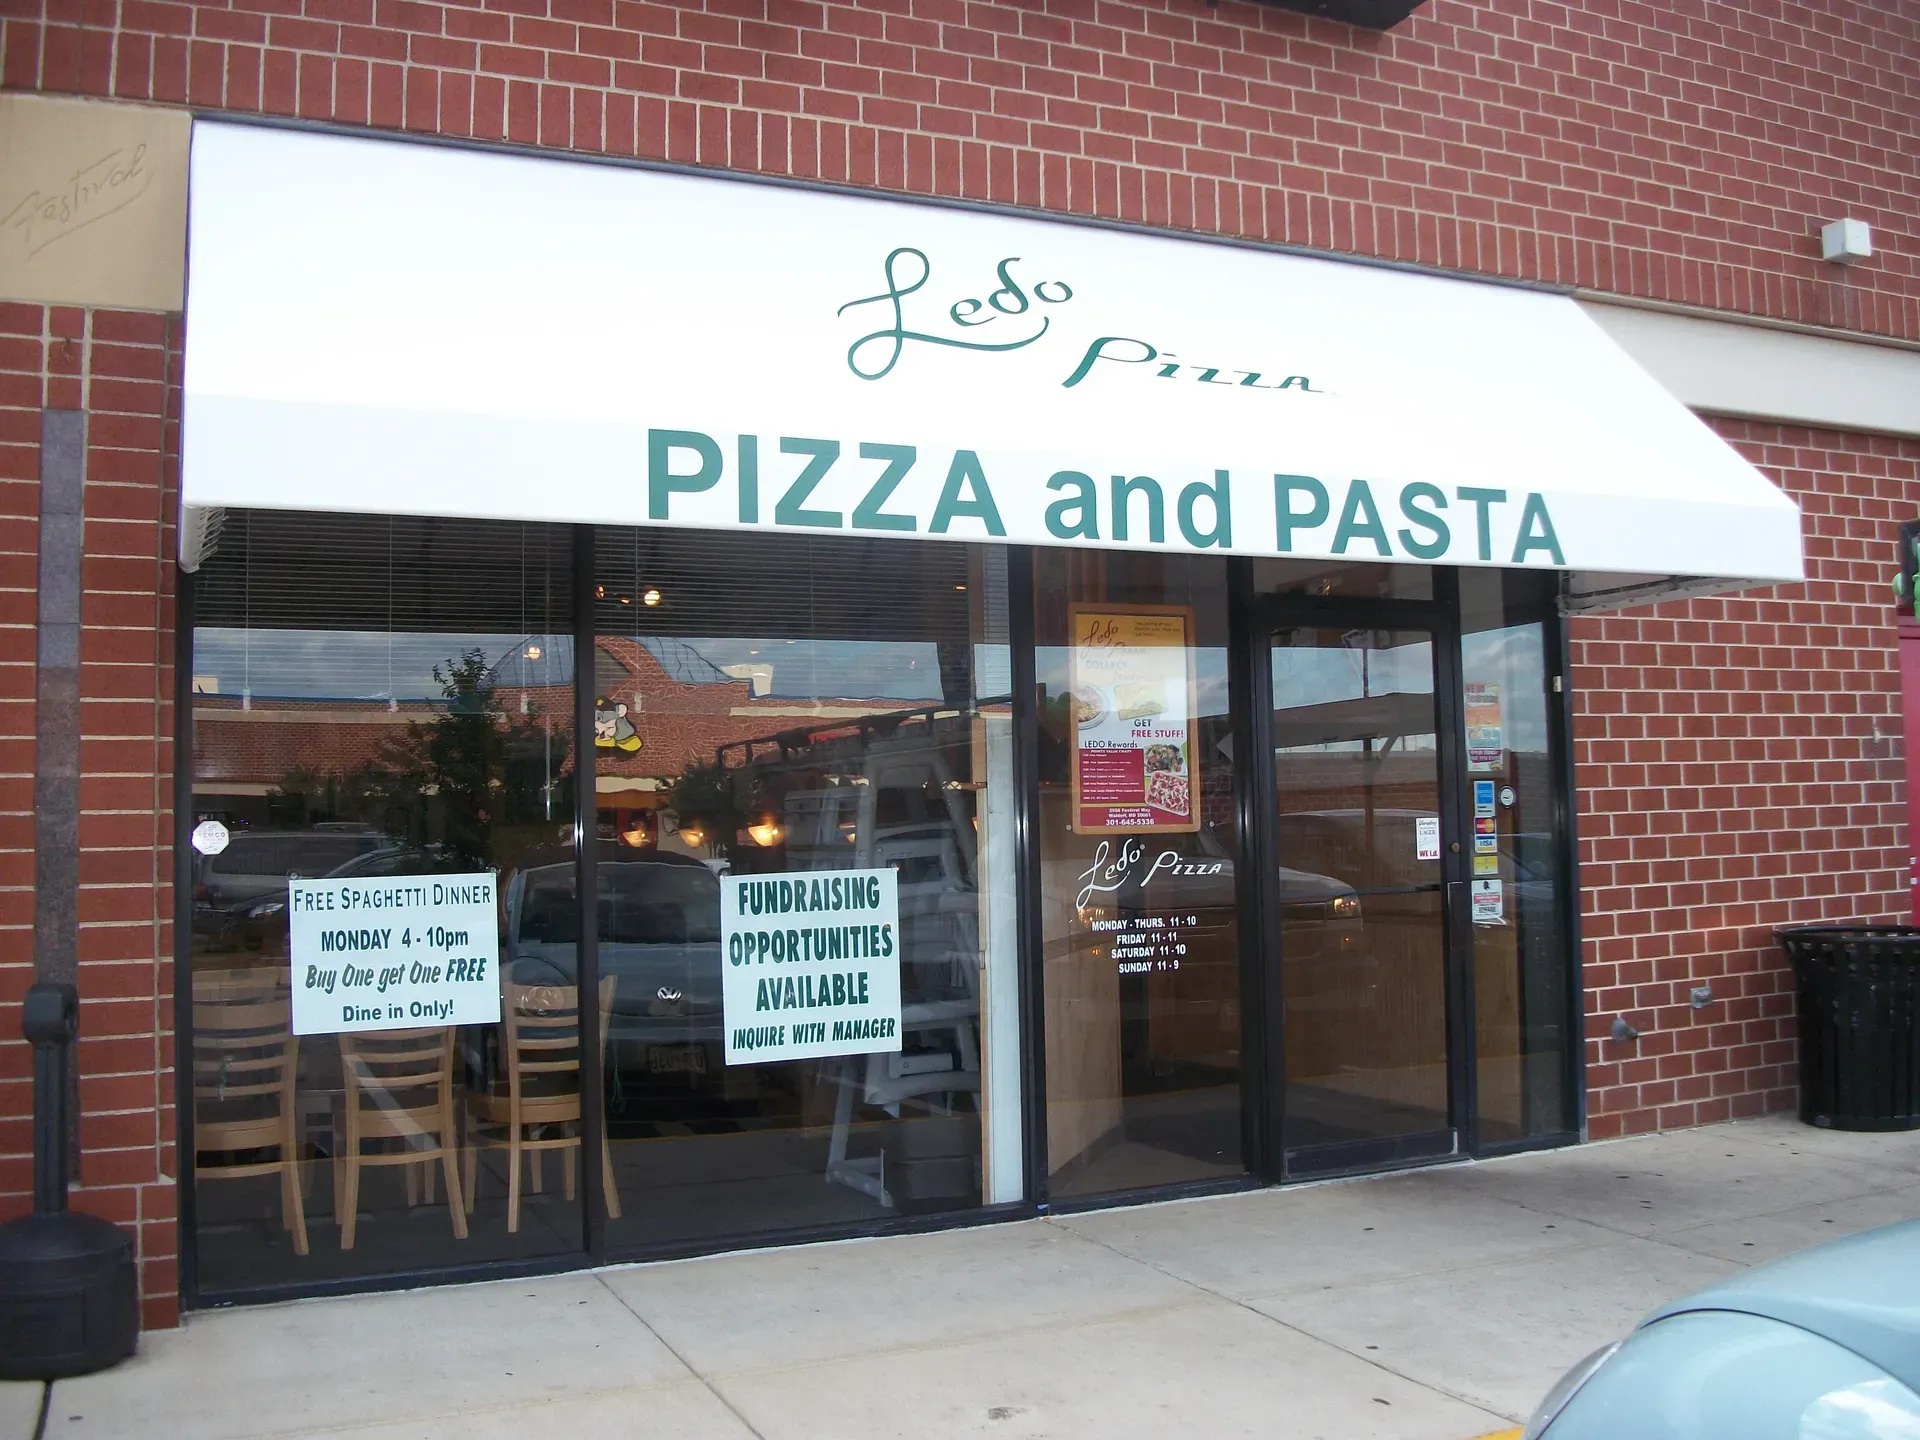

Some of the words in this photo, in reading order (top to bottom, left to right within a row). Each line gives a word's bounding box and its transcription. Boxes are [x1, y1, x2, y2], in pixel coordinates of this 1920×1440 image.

[837, 247, 1073, 380] Ledo
[1061, 336, 1324, 394] Pizza
[647, 427, 1008, 537] PIZZA
[1044, 469, 1233, 548] and
[1274, 473, 1566, 565] PASTA
[1131, 730, 1151, 738] FREE
[1155, 730, 1184, 738] STUFF!
[1134, 719, 1151, 727] GET
[1084, 740, 1105, 748] LEDO
[1107, 740, 1138, 748] Rewards
[1075, 838, 1141, 910] Ledo
[294, 889, 335, 912] FREE
[341, 887, 426, 909] SPAGHETTI
[433, 883, 491, 906] DINNER
[738, 875, 880, 916] FUNDRAISING
[1092, 919, 1128, 932] MONDAY
[1134, 918, 1165, 929] THURS.
[1170, 917, 1179, 927] 11
[1186, 916, 1197, 926] 10
[321, 928, 392, 952] MONDAY
[401, 927, 412, 948] 4
[426, 926, 469, 952] 10pm
[729, 923, 893, 967] OPPORTUNITIES
[1111, 946, 1154, 959] SATURDAY
[1159, 945, 1169, 956] 11
[1175, 944, 1186, 955] 10
[1116, 934, 1146, 945] FRIDAY
[1151, 932, 1160, 943] 11
[1167, 931, 1177, 942] 11
[305, 964, 337, 995] Buy
[341, 963, 374, 987] One
[377, 963, 406, 994] get
[409, 960, 441, 984] One
[445, 957, 488, 982] FREE
[1118, 961, 1152, 974] SUNDAY
[1157, 960, 1167, 971] 11
[1173, 959, 1179, 970] 9
[756, 971, 869, 1012] AVAILABLE
[342, 1005, 382, 1022] Dine
[388, 1003, 404, 1019] in
[409, 999, 454, 1020] Only!
[732, 1025, 785, 1051] INQUIRE
[792, 1022, 826, 1045] WITH
[832, 1017, 896, 1042] MANAGER
